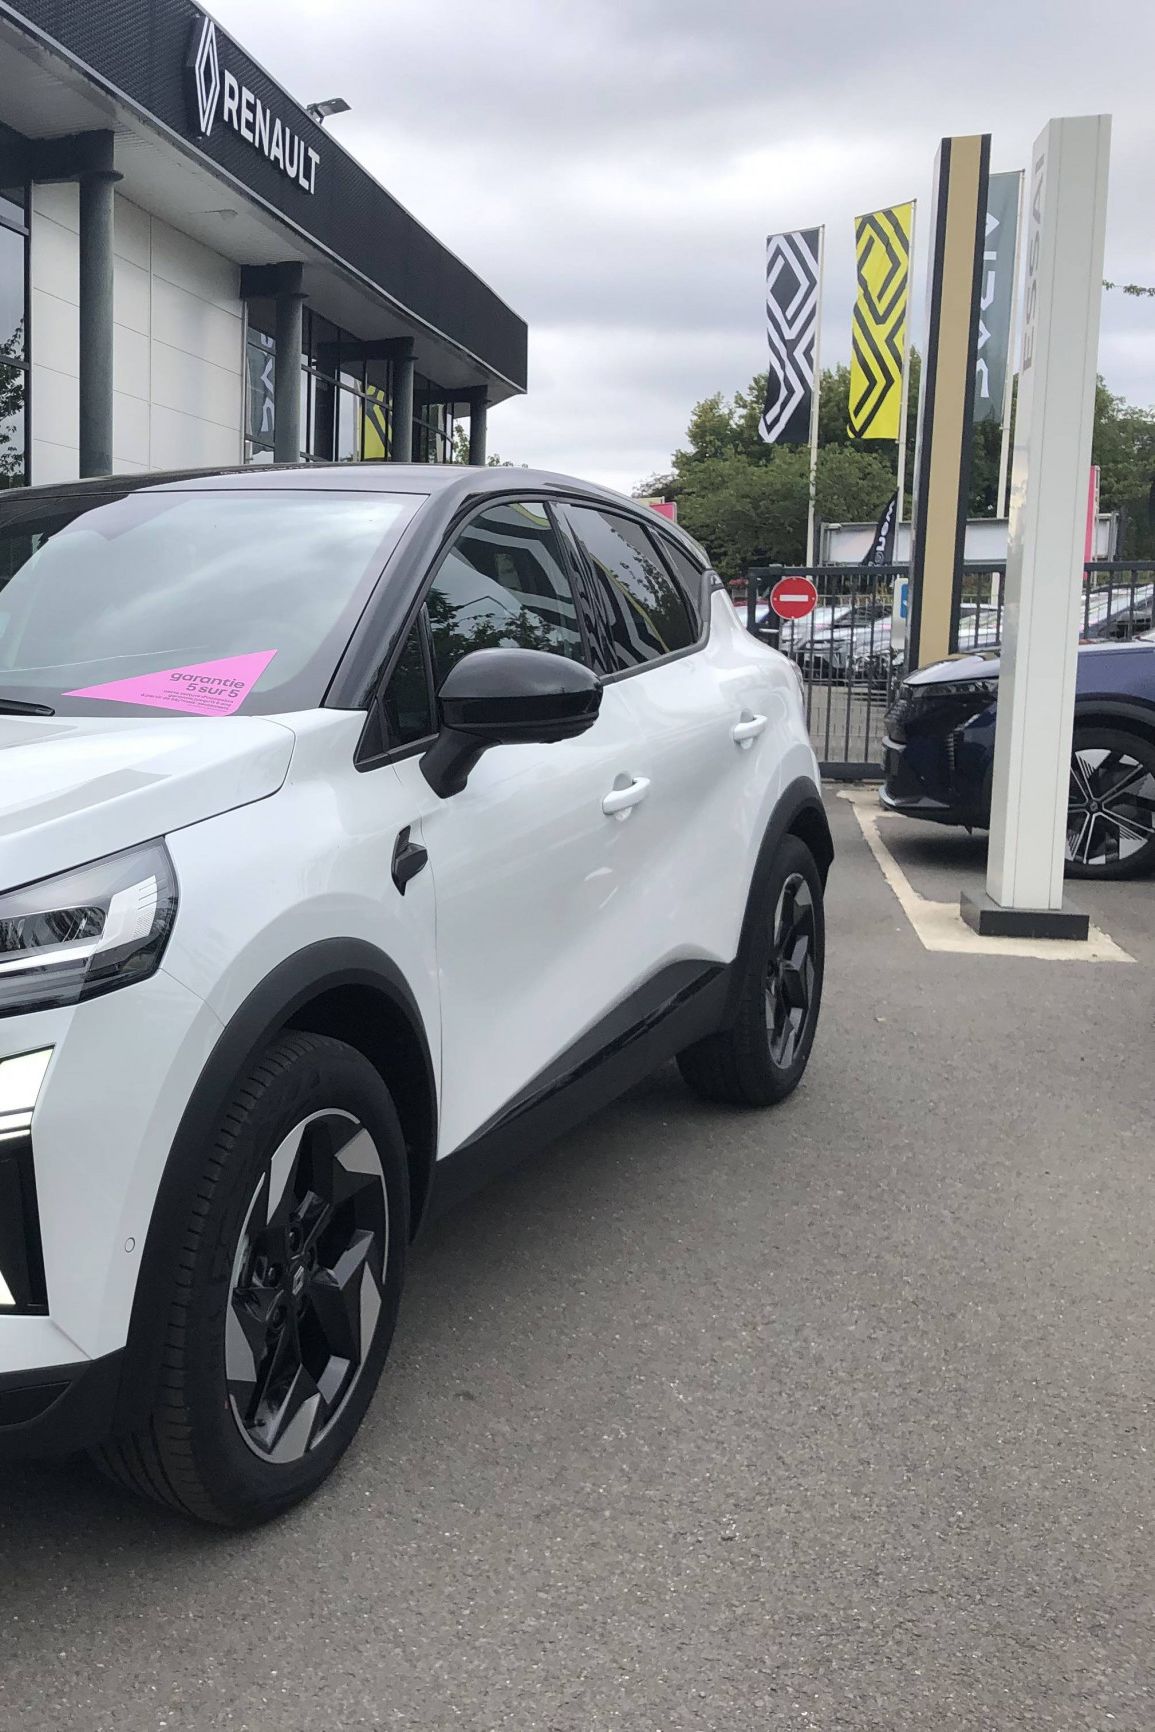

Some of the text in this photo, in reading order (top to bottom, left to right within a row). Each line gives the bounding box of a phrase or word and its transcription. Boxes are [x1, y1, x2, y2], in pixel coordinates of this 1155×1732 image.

[223, 69, 320, 194] RENAULT
[1023, 153, 1045, 371] ESSAI
[170, 672, 245, 688] garantie
[186, 683, 240, 698] 5 sur 5
